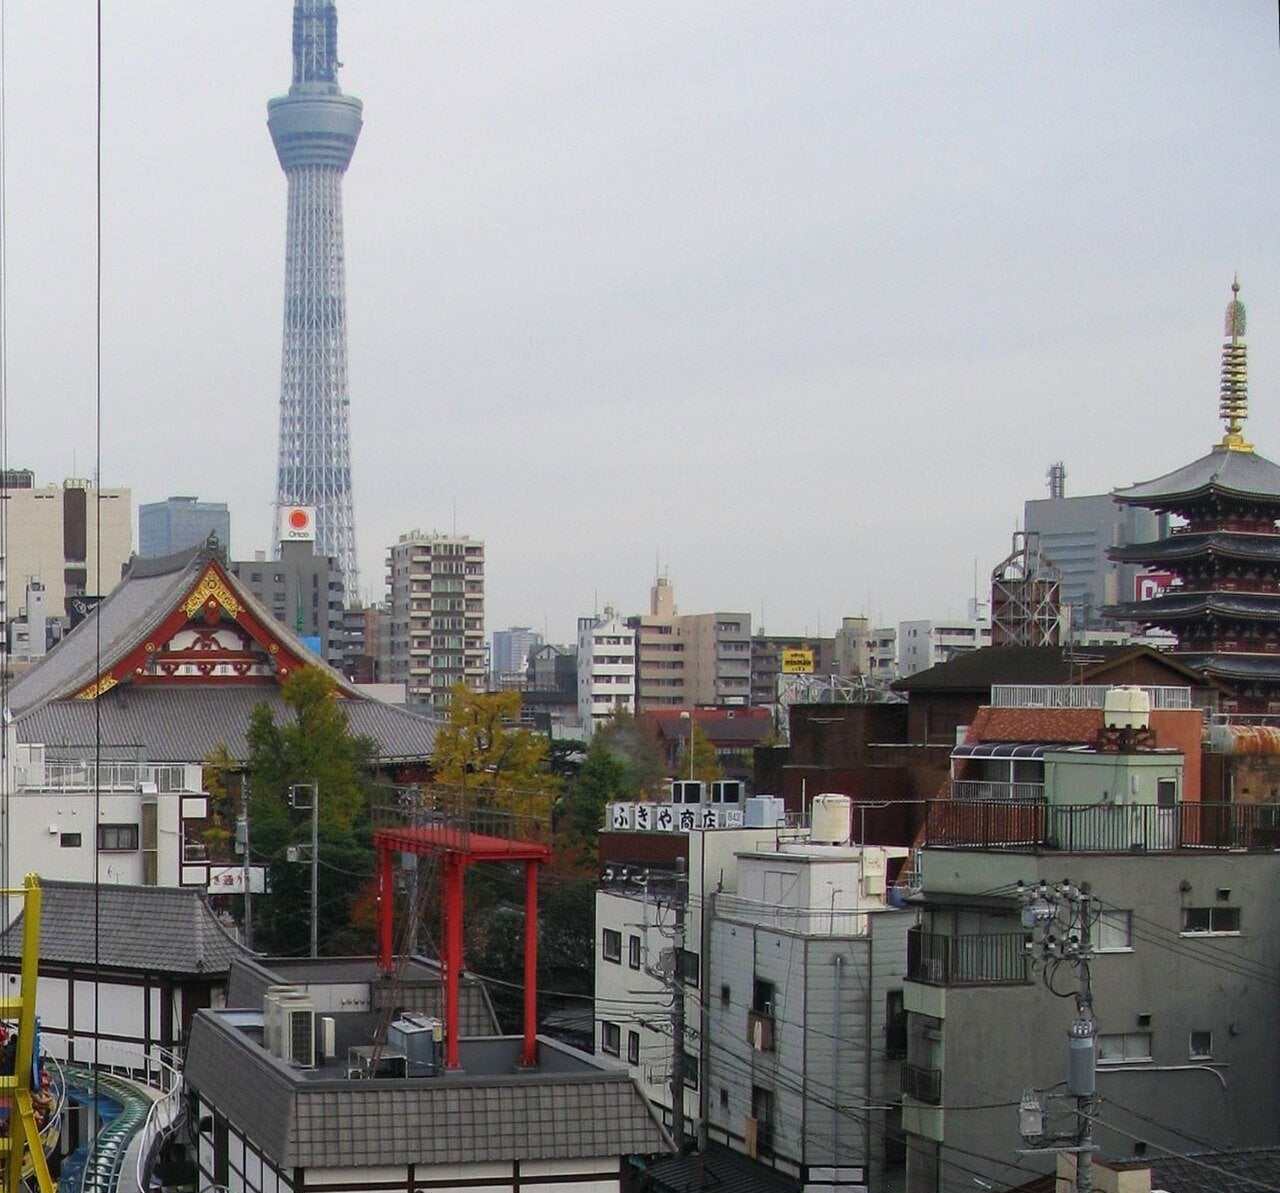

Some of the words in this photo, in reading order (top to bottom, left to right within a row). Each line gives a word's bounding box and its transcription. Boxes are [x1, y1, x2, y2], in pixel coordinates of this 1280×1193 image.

[614, 806, 716, 829] ふきや商店
